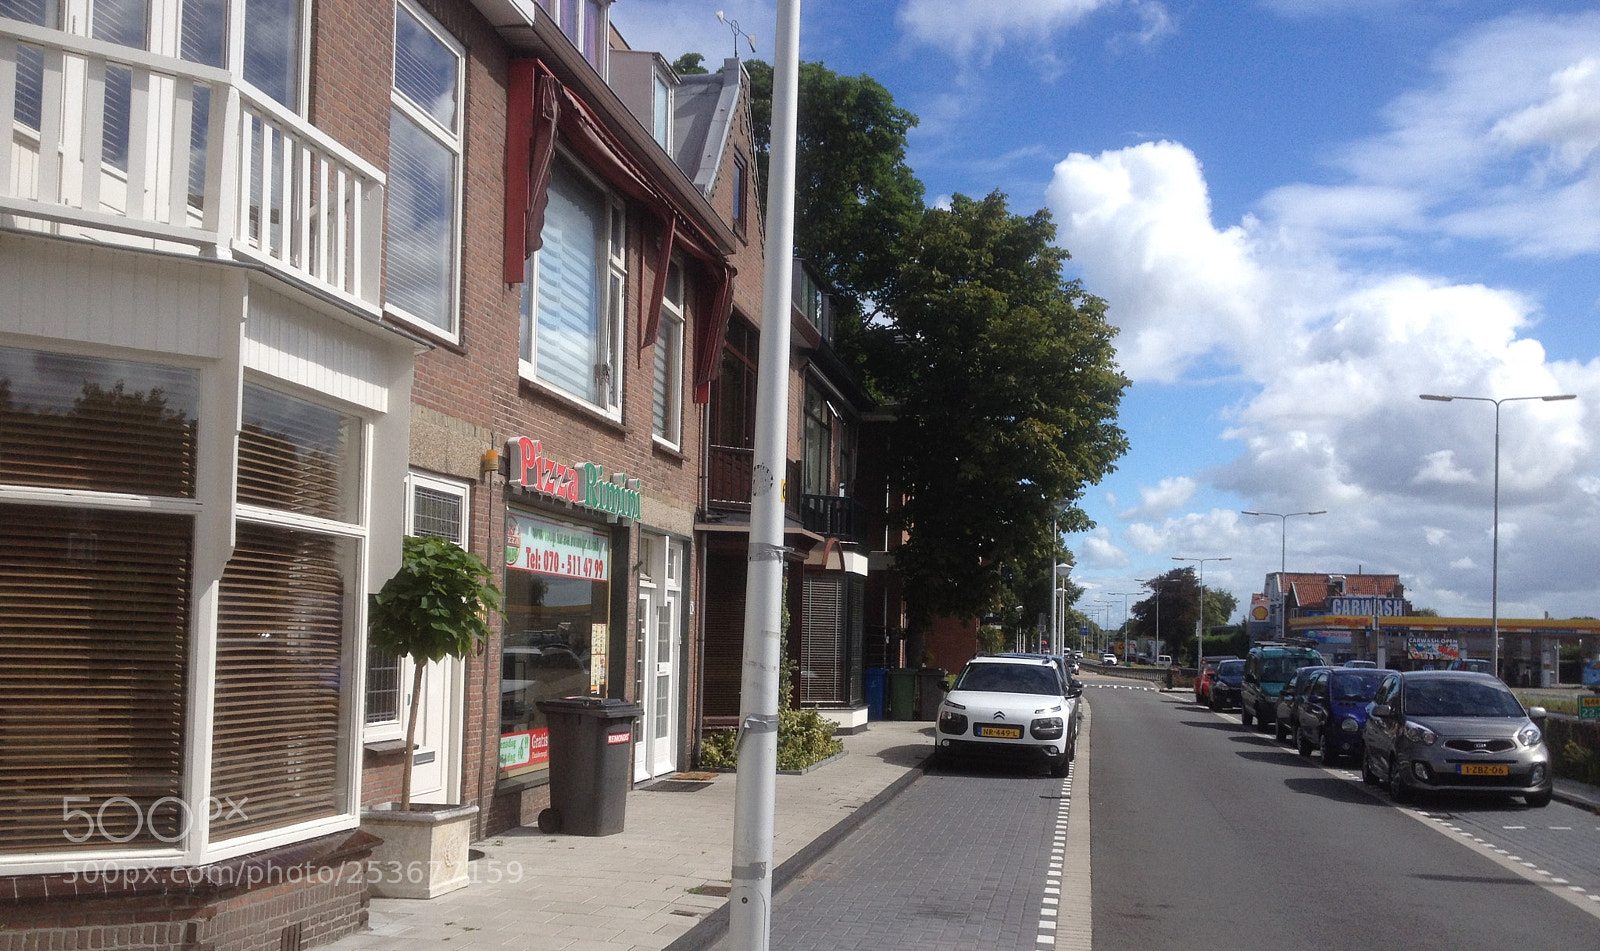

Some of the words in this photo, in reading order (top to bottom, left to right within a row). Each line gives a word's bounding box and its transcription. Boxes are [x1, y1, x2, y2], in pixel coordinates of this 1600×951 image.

[517, 436, 579, 503] Pizza
[583, 462, 641, 520] Rimini
[525, 546, 541, 570] Tel:
[543, 550, 559, 573] 070
[567, 554, 581, 576] 511
[583, 557, 593, 577] 47
[594, 559, 604, 579] 99
[1332, 598, 1403, 616] CARWASH
[531, 732, 548, 749] Gratis
[983, 728, 1018, 737] NR-449-L
[1465, 766, 1504, 775] 1-ZBZ-06
